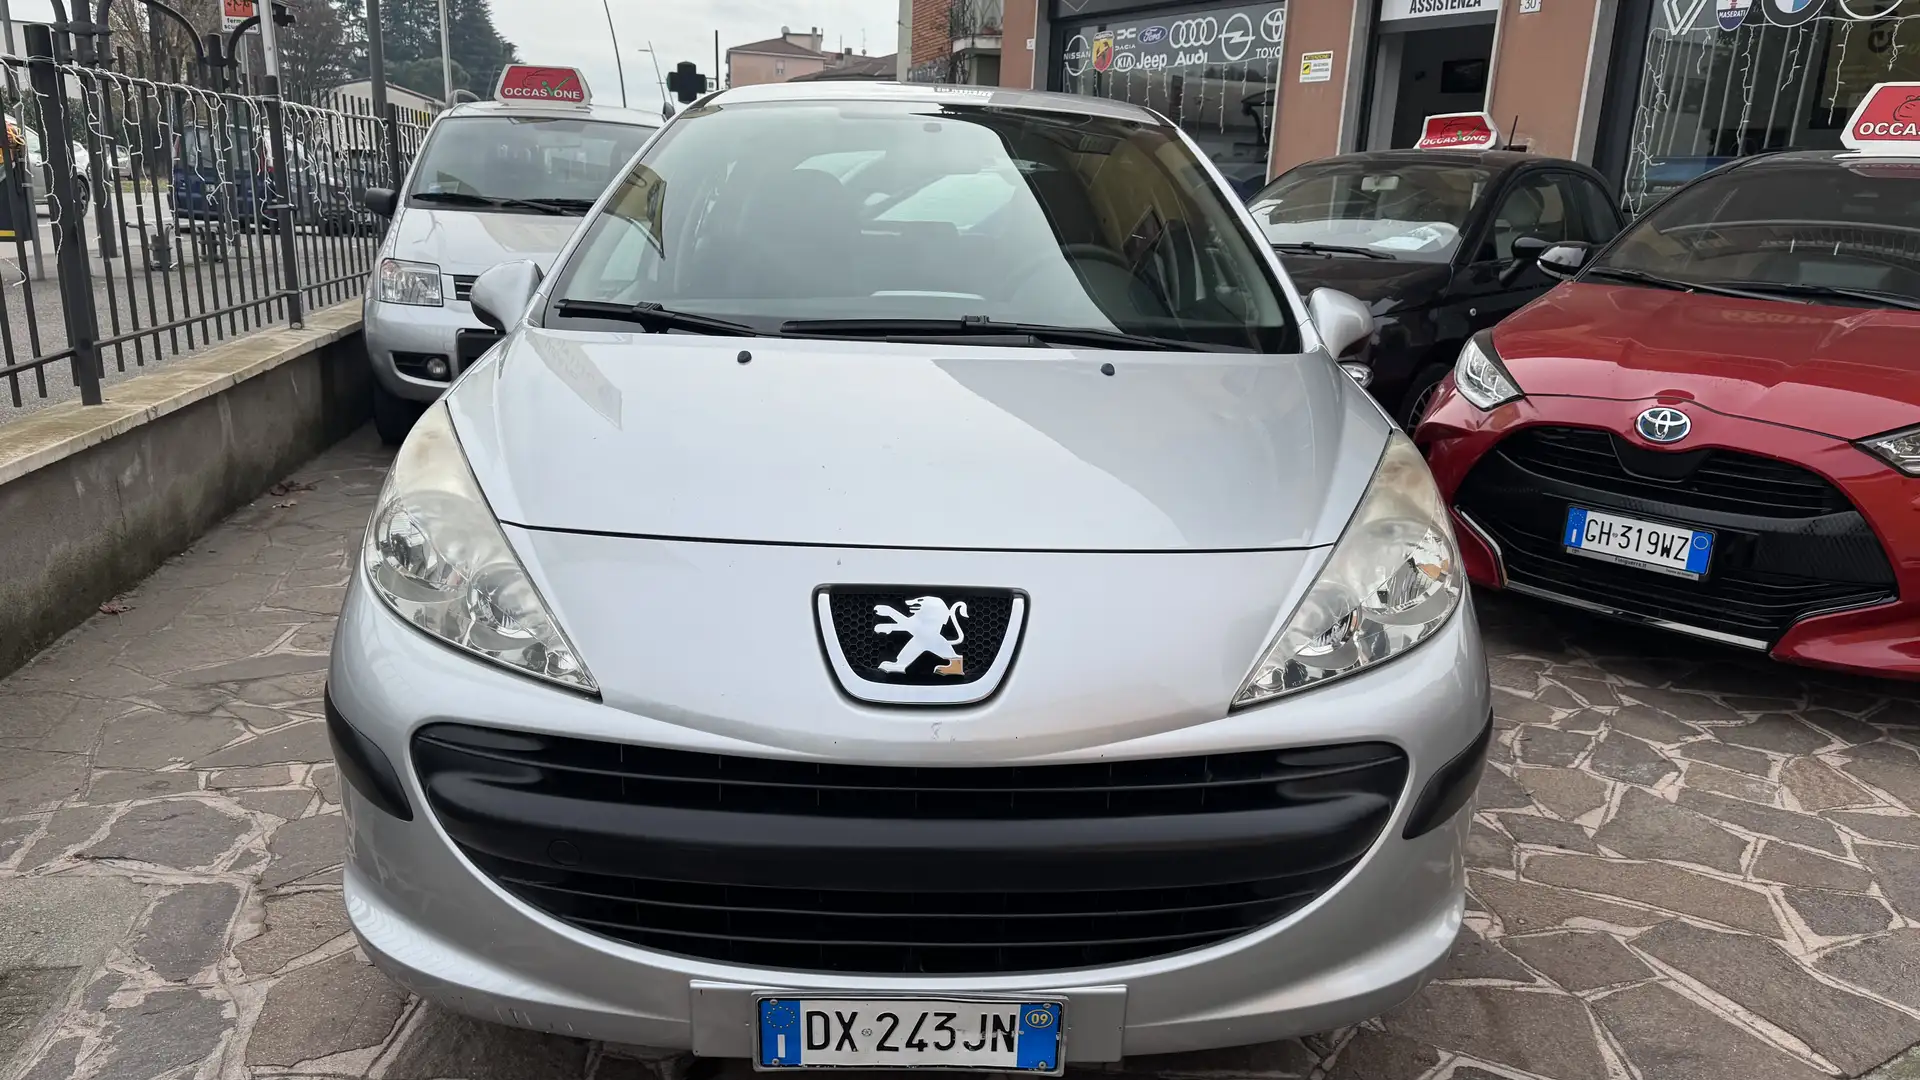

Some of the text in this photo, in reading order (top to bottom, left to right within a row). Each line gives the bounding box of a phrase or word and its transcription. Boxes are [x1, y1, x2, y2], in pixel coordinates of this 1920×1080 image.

[1719, 9, 1747, 19] MASERATI
[1142, 29, 1162, 42] Ford
[1063, 51, 1091, 60] NISSAN
[1117, 56, 1132, 68] KIA
[1136, 52, 1168, 71] Jeep
[1174, 49, 1208, 67] Audi
[1030, 1012, 1049, 1026] 09
